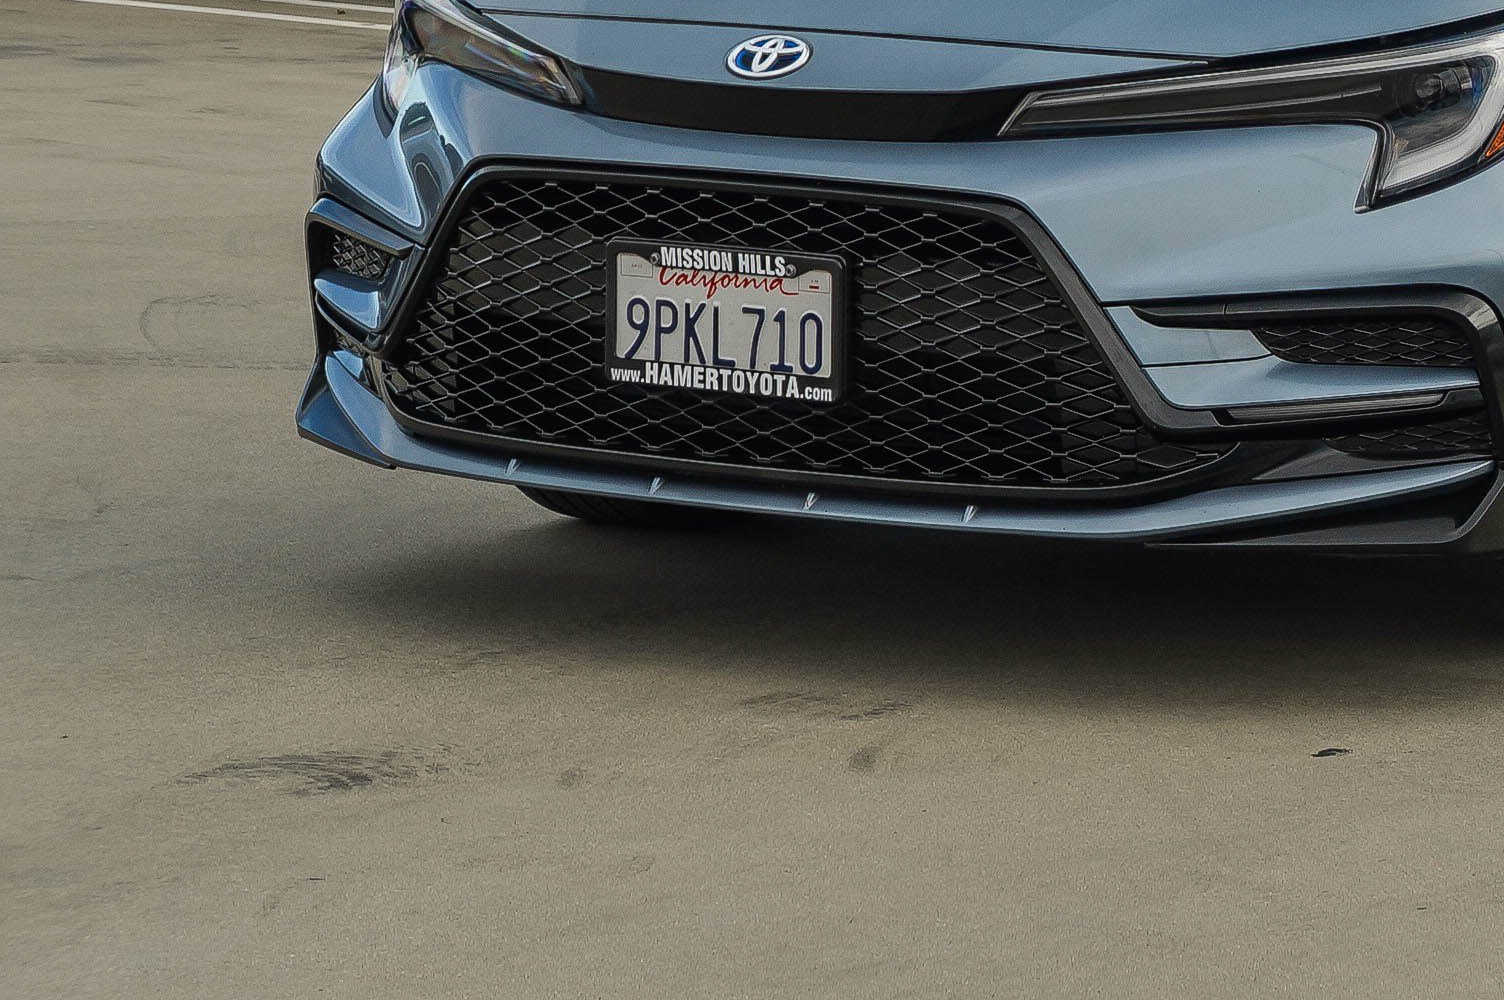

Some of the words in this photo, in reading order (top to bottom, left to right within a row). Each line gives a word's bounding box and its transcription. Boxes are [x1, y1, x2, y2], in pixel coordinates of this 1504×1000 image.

[660, 246, 733, 272] MISSION
[738, 253, 786, 277] HILLS
[659, 266, 799, 299] California
[624, 297, 823, 375] 9PKL710
[610, 361, 833, 402] www.HAMERTOYOTA.com
